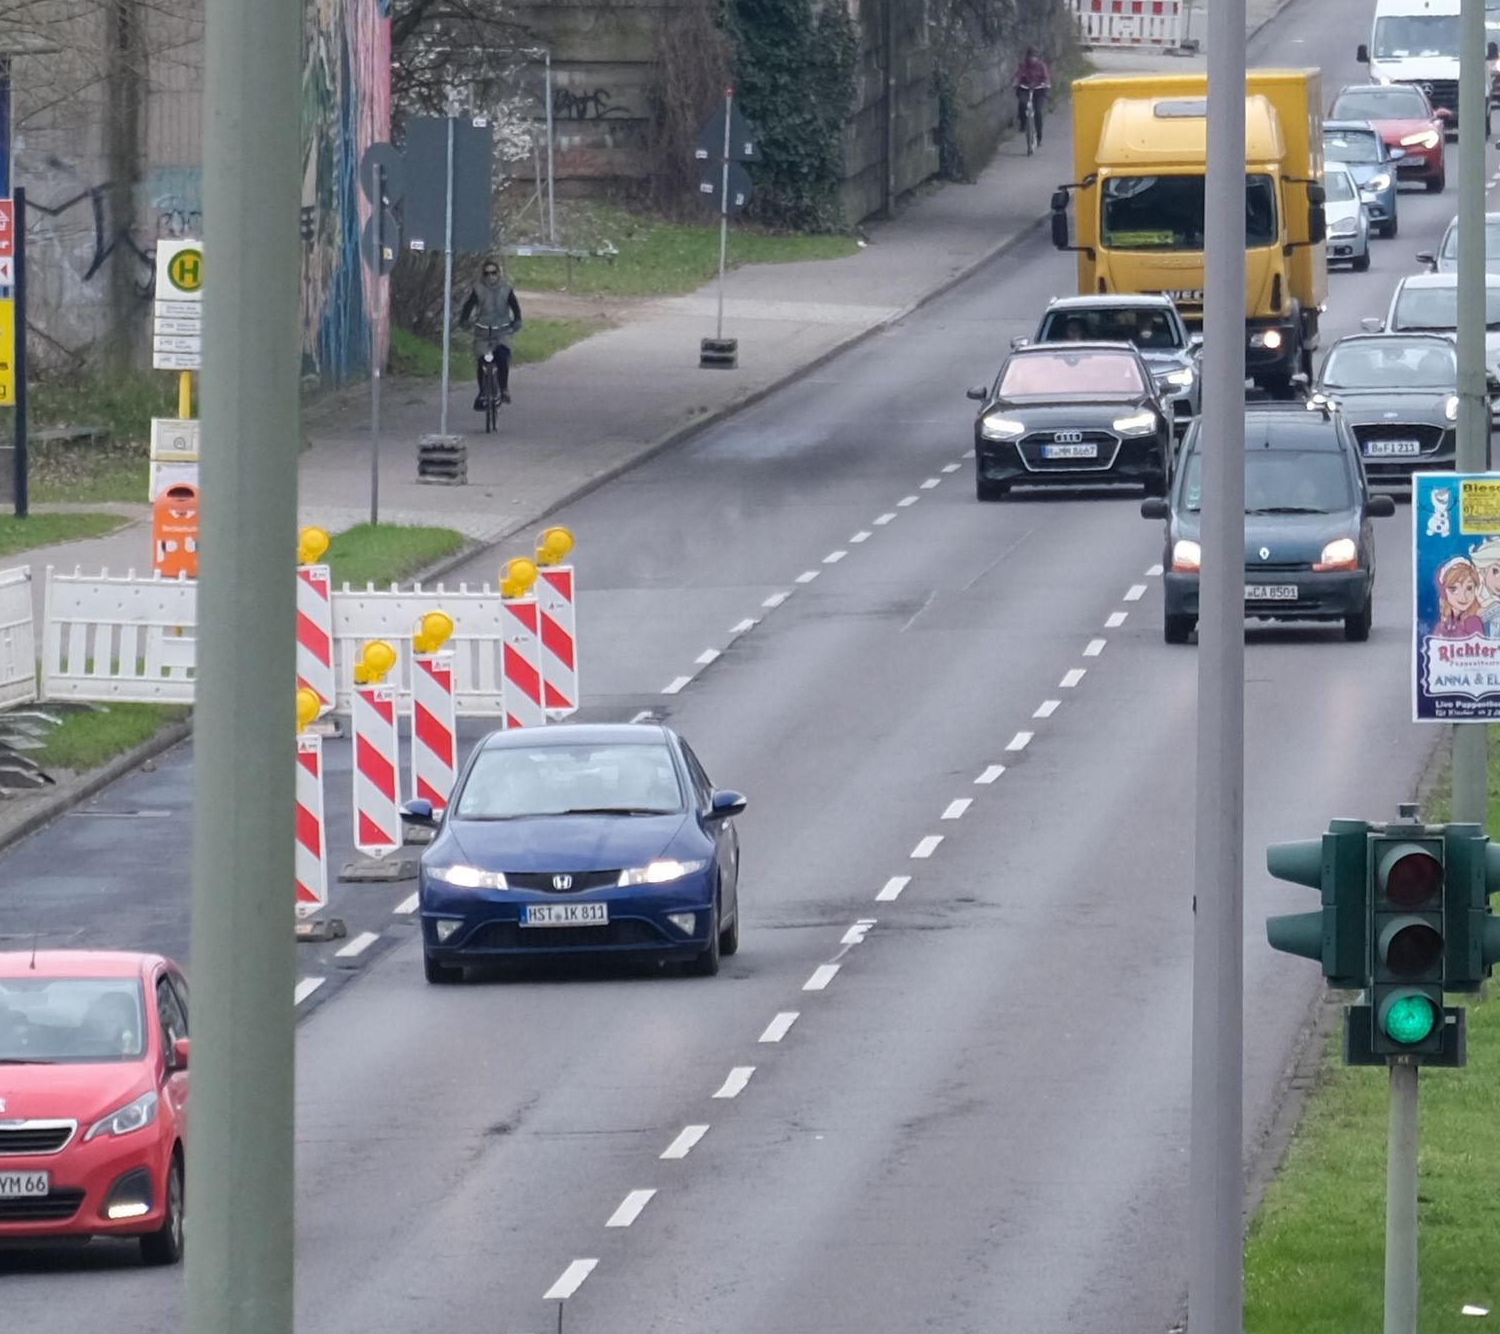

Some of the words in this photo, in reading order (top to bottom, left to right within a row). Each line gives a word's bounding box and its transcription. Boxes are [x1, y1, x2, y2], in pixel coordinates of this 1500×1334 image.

[1434, 674, 1471, 687] ANNA
[1474, 673, 1483, 685] &
[528, 907, 553, 923] HST
[563, 907, 579, 921] IK
[581, 905, 605, 920] 811
[25, 1175, 47, 1193] 66
